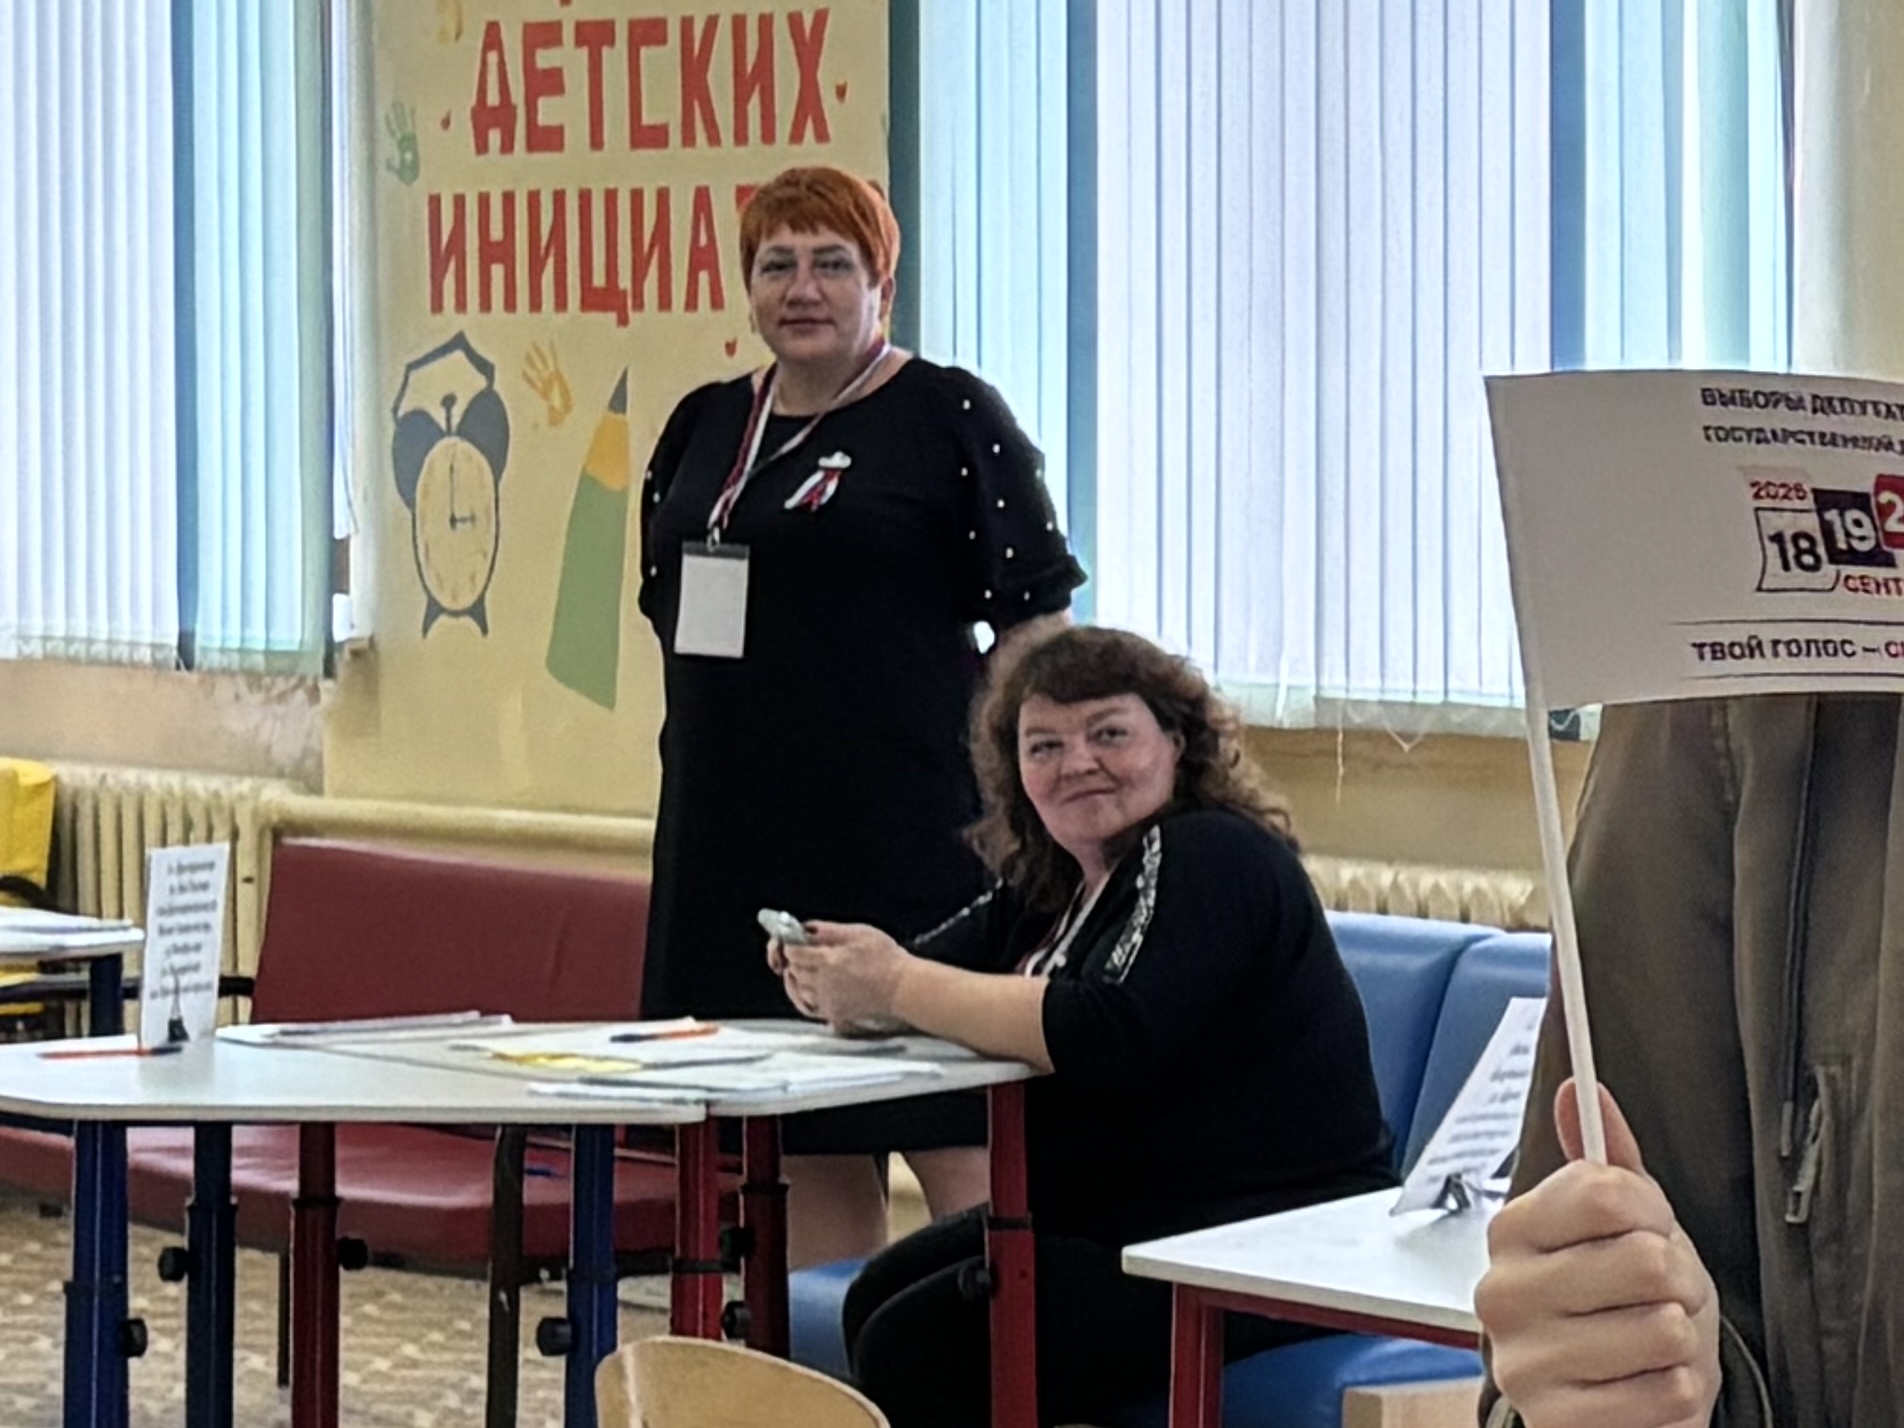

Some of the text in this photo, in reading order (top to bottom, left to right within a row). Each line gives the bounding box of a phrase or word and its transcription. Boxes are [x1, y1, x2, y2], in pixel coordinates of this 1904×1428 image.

[471, 7, 831, 156] ДЕТСКИХ
[1701, 387, 1806, 412] ВЫБОРЫ
[1703, 425, 1896, 453] ГОСУДАРСТВЕННОЙ
[1767, 529, 1822, 573] 18
[1824, 508, 1878, 552] 19
[1690, 634, 1766, 661] ТВОЙ
[1770, 637, 1857, 658] ГОЛОС
